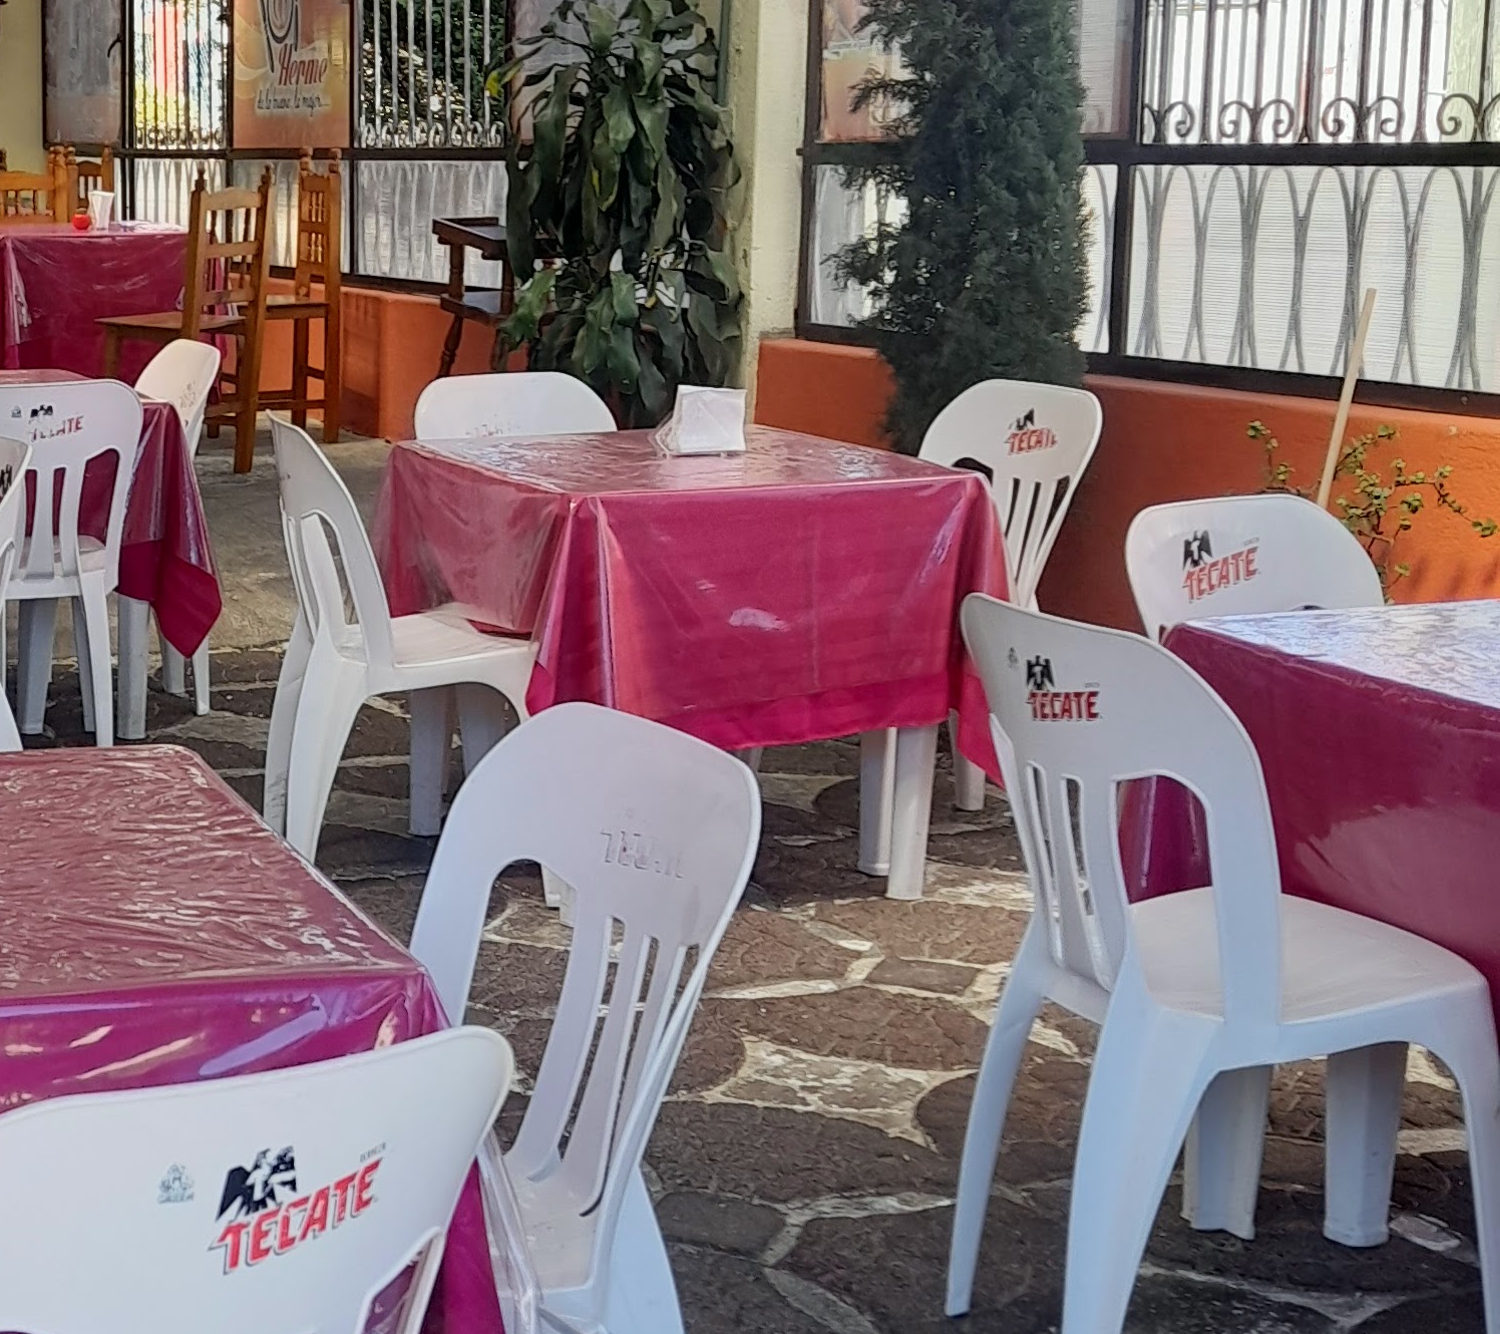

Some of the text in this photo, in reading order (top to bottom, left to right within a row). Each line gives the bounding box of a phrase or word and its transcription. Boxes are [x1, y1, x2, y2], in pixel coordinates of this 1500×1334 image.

[279, 43, 328, 86] Herme
[1182, 547, 1260, 604] TECATE
[1025, 691, 1100, 722] TECATE
[208, 1157, 383, 1275] TECATE
